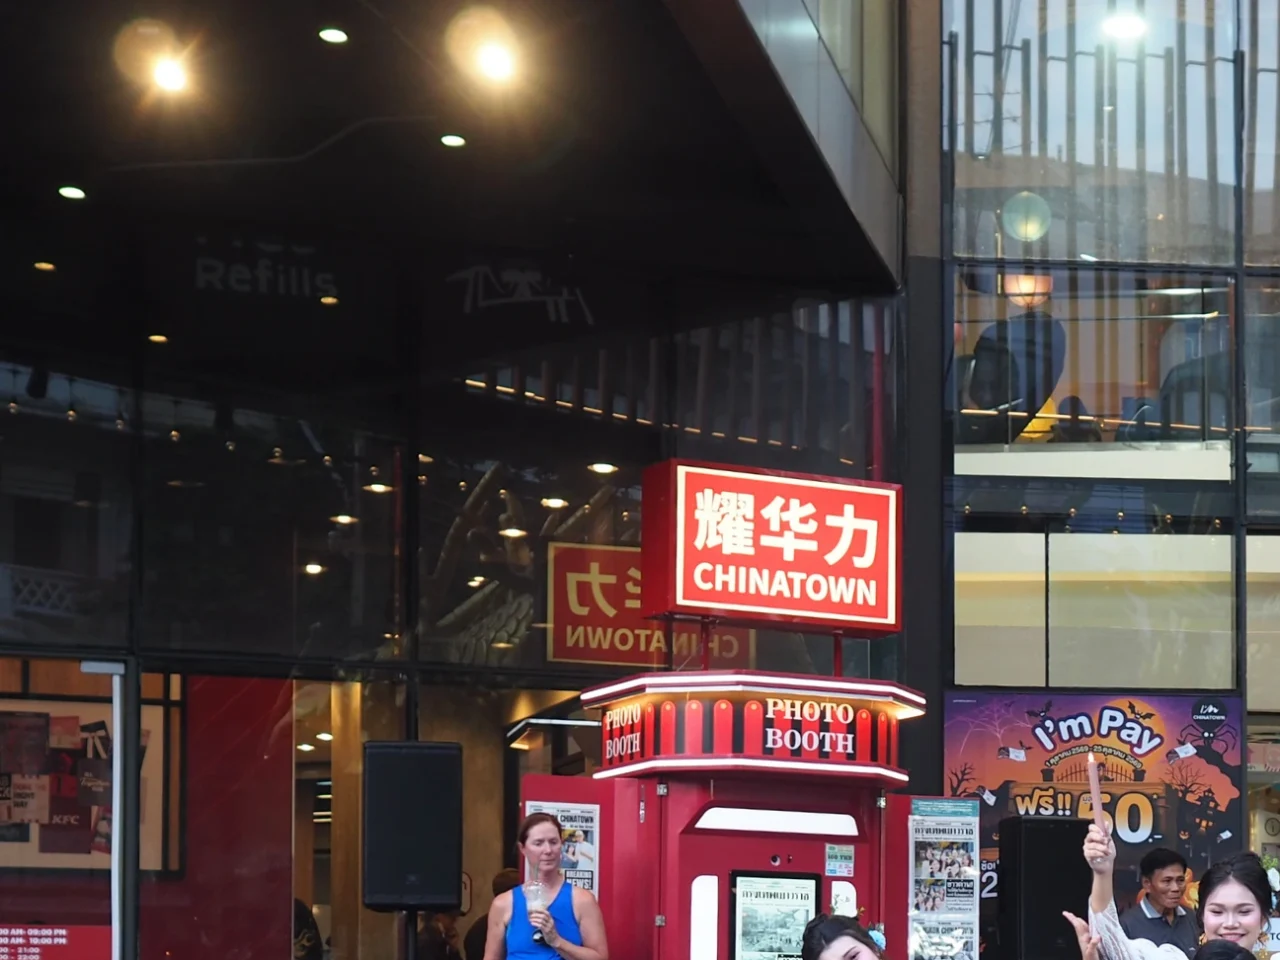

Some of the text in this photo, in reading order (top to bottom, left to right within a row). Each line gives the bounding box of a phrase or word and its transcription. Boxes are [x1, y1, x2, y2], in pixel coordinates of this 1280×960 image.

[195, 257, 338, 297] Refills
[693, 488, 878, 568] 耀华力
[693, 562, 877, 606] CHINATOWN
[605, 703, 641, 730] PHOTO
[765, 698, 854, 724] PHOTO
[765, 728, 854, 753] BOOTH
[1100, 709, 1162, 755] Pay
[605, 732, 641, 759] BOOTH
[52, 815, 79, 824] KFC
[560, 814, 594, 824] CHINATOWN
[54, 928, 67, 936] PM
[54, 937, 67, 945] PM
